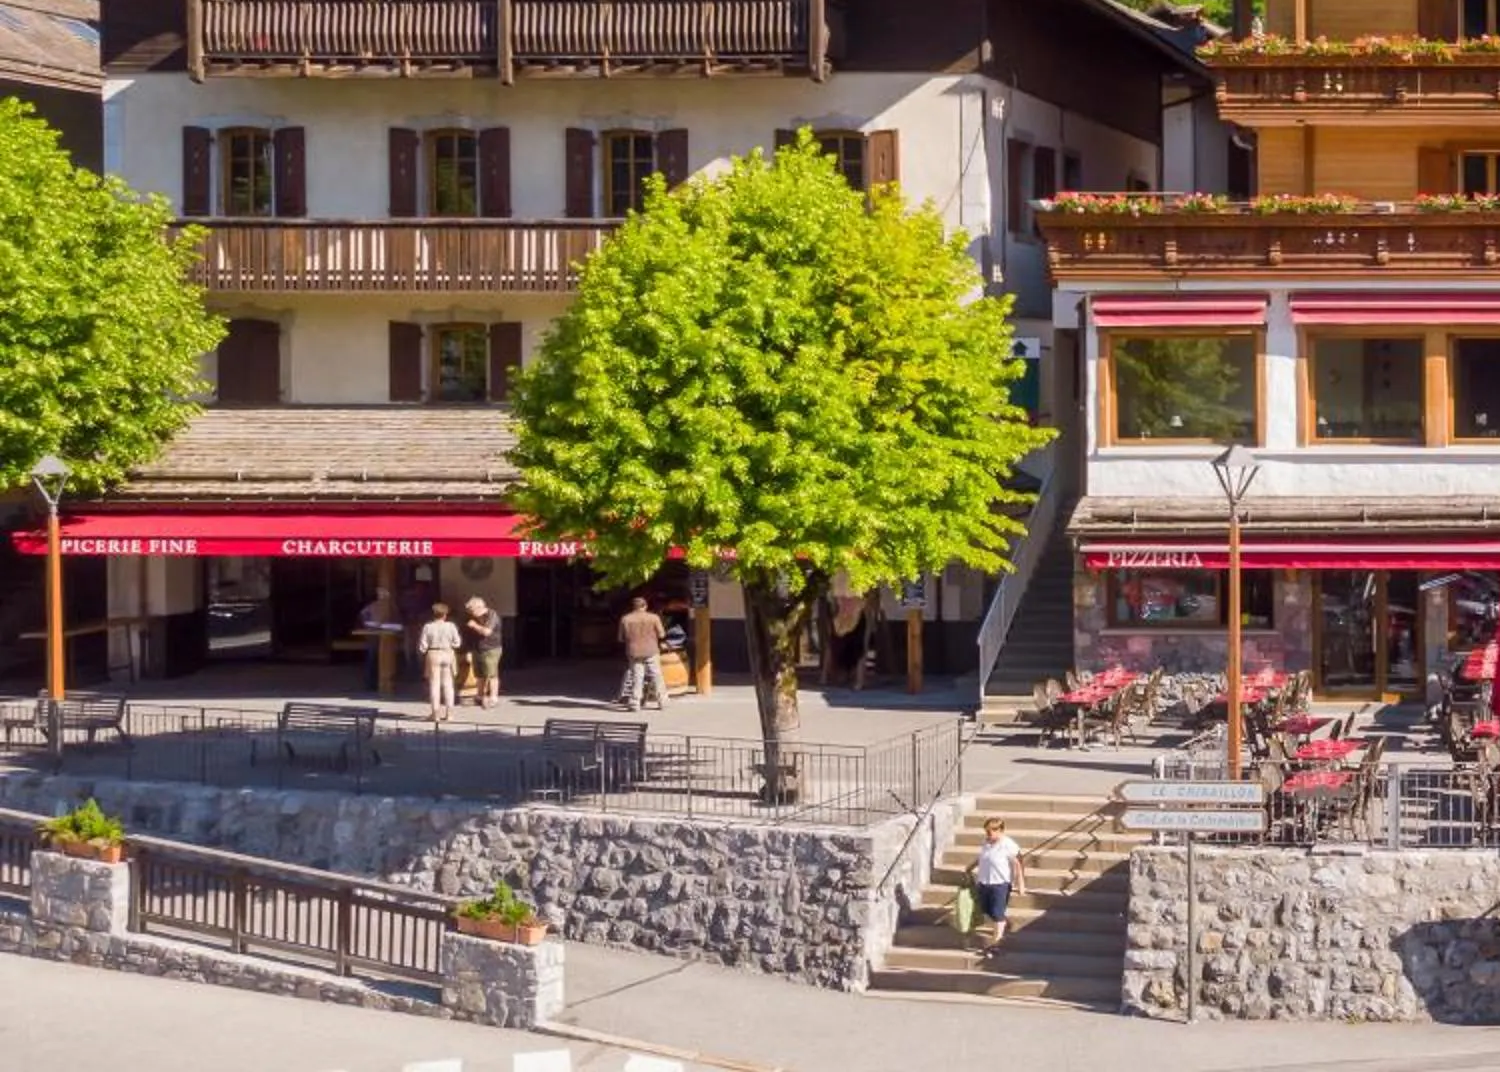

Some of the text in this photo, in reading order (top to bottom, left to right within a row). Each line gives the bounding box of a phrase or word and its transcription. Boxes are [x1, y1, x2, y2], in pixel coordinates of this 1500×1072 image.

[61, 539, 197, 553] PICERIE FINE
[281, 539, 433, 555] CHARCUTERIE
[1107, 550, 1203, 567] PIZZERIA
